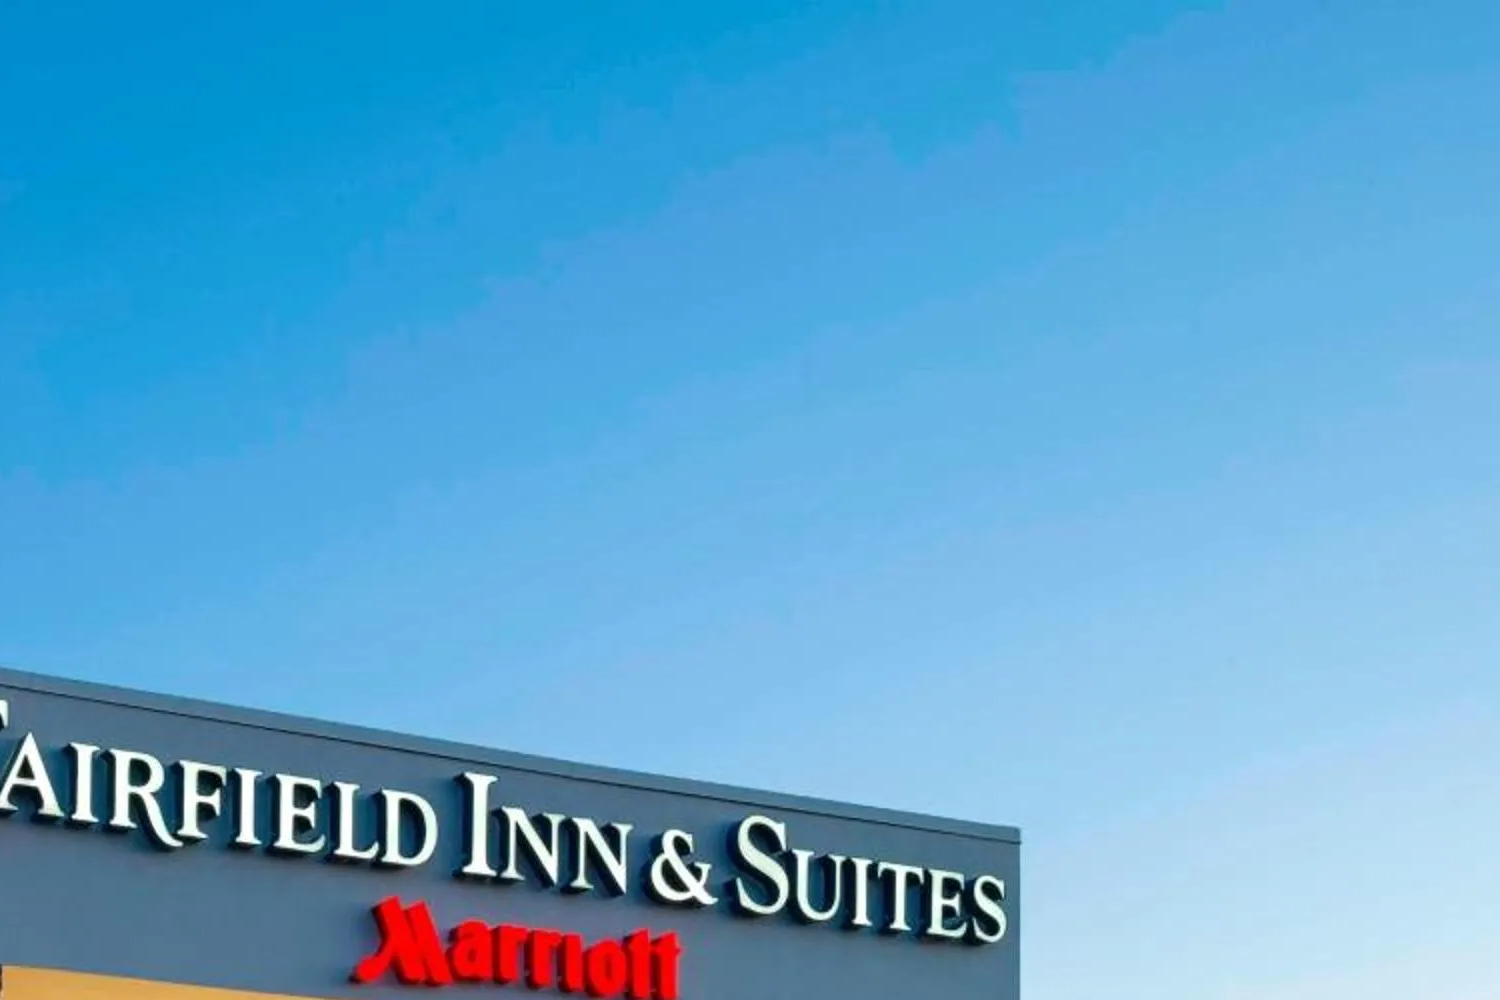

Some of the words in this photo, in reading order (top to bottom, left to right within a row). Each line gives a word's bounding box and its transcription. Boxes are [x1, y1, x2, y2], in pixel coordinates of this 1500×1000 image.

[457, 772, 633, 894] INN
[648, 828, 719, 906] &
[735, 814, 1007, 944] SUITES
